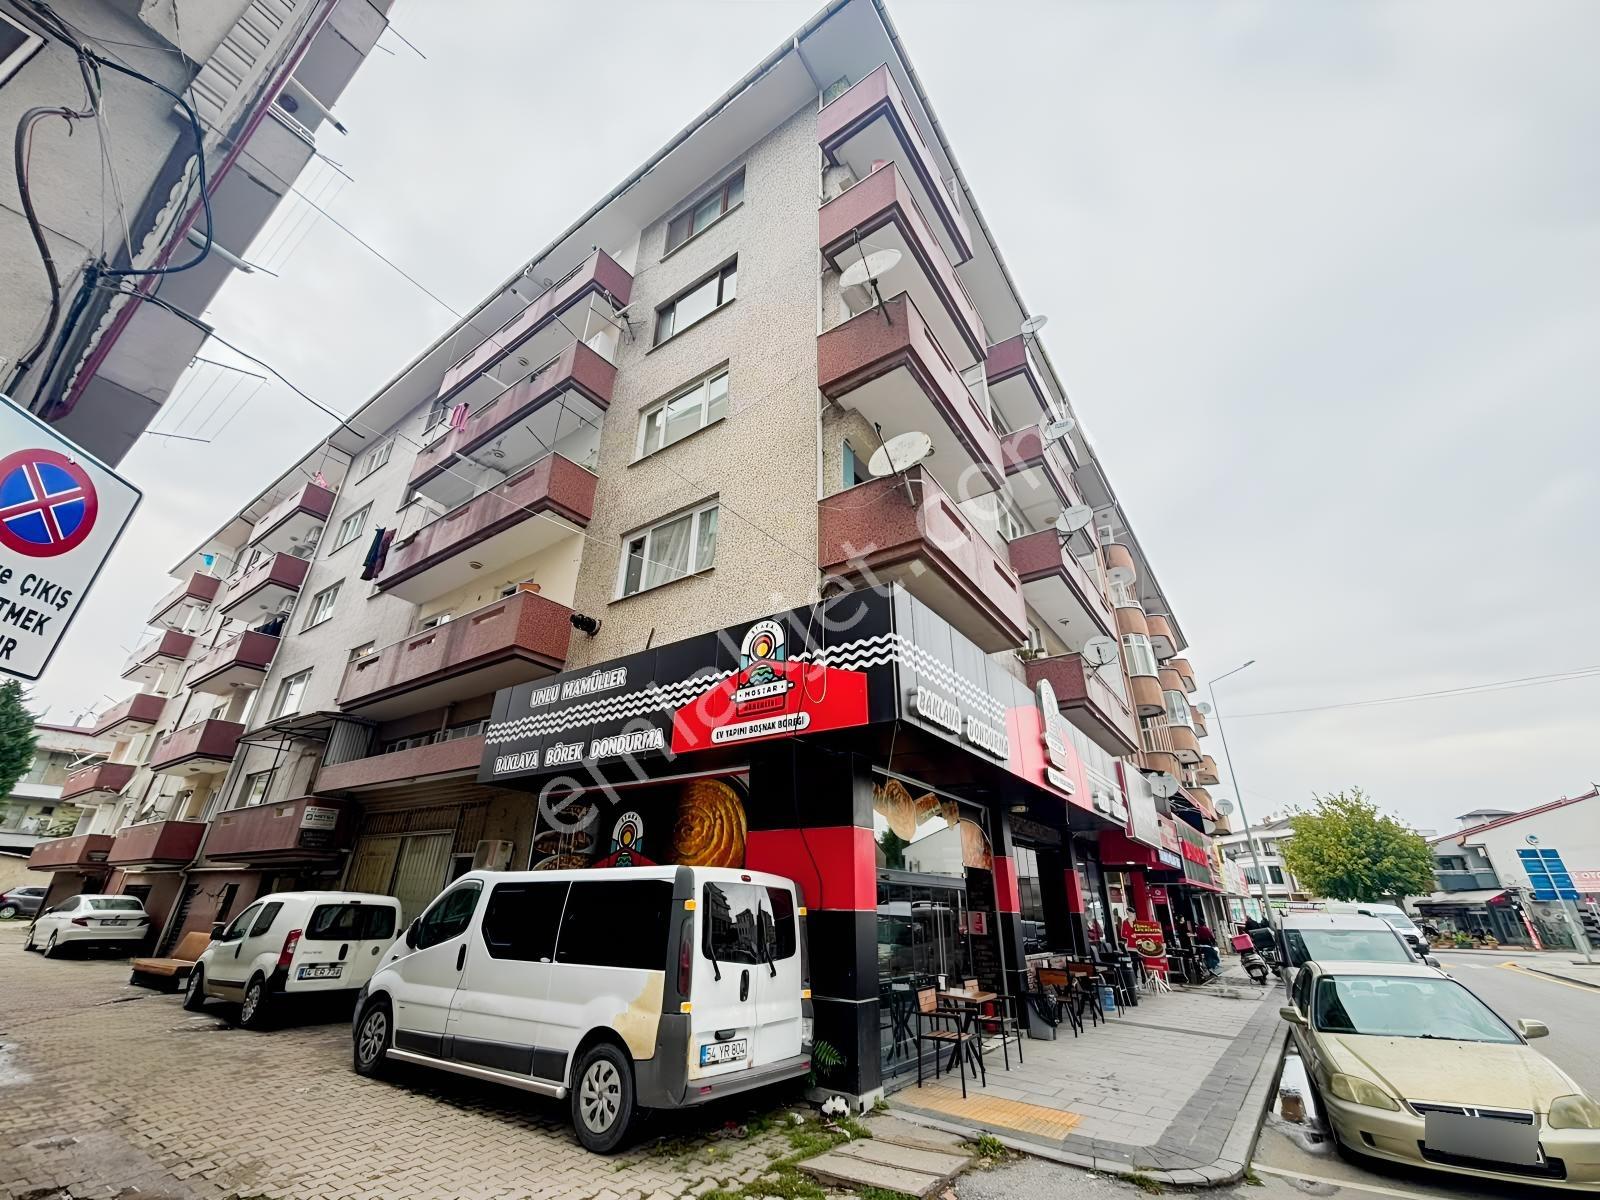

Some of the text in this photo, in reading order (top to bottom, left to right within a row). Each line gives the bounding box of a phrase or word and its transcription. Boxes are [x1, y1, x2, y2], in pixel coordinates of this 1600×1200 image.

[20, 574, 72, 611] ÇIKIŞ
[531, 668, 627, 707] UNLU MAMÜLLER
[744, 685, 778, 698] MOSTAR
[917, 685, 961, 735] BAKLAVA
[716, 730, 724, 739] EV
[726, 726, 747, 738] YAPIMI
[748, 721, 777, 734] BOŞNAK
[494, 729, 664, 774] BAKLAVA BÖREK DONDURMA
[706, 1042, 745, 1060] 54 YR 804
